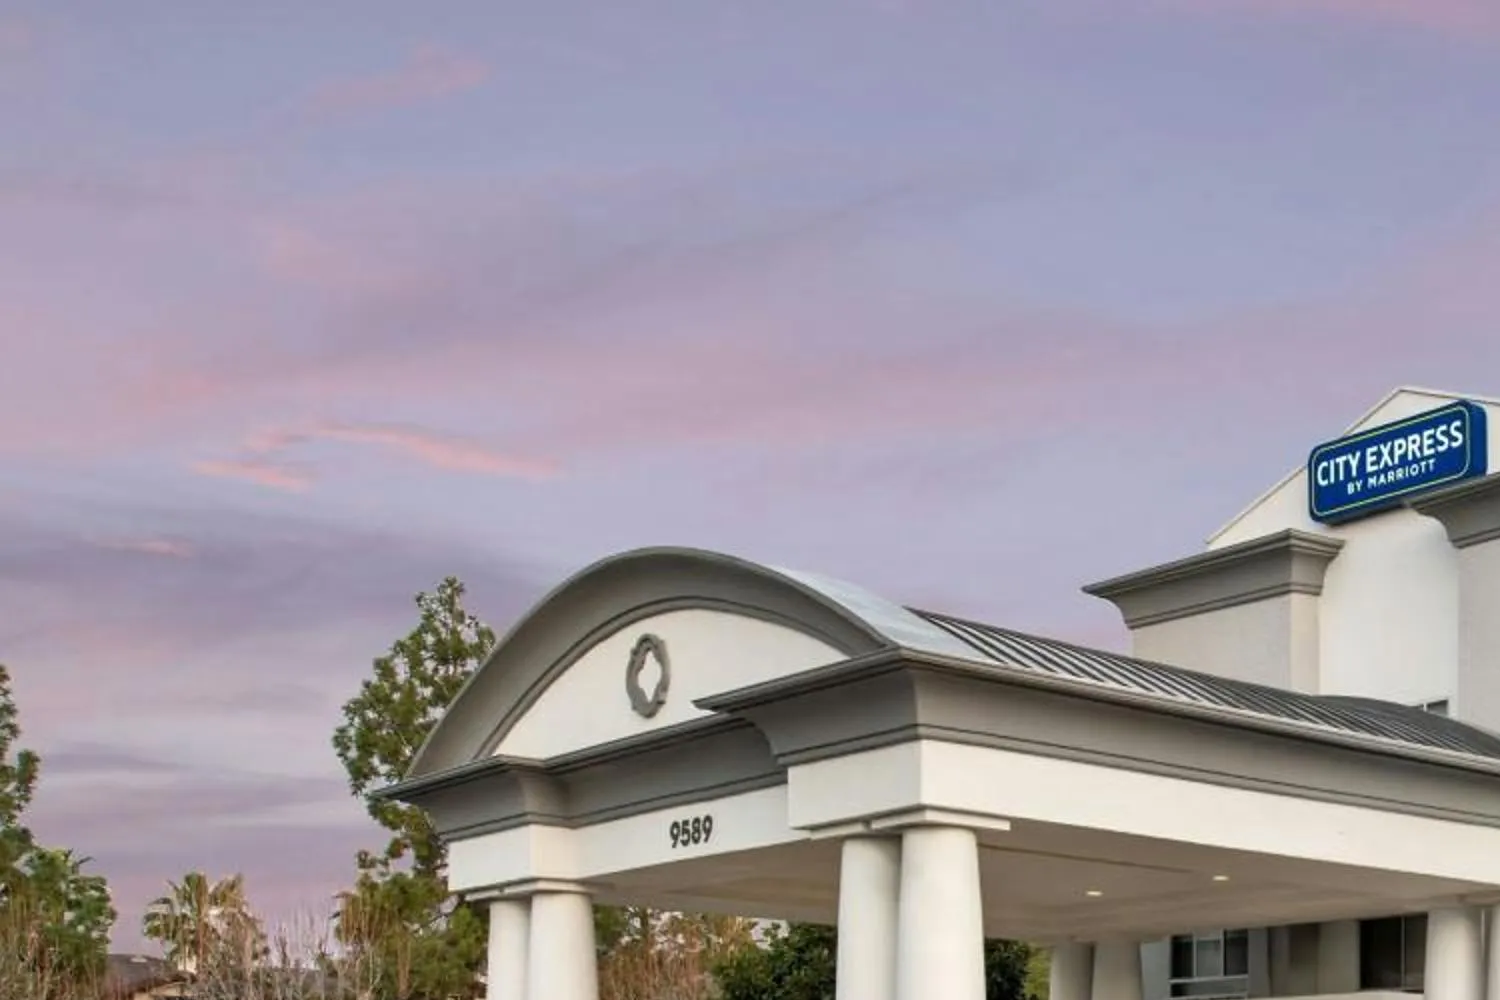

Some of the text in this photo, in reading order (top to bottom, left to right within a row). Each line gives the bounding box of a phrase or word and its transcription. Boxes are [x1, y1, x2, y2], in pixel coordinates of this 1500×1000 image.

[1317, 420, 1463, 487] CITY EXPRESS
[1347, 458, 1437, 495] BY MARRIOTT
[670, 815, 713, 848] 9589
